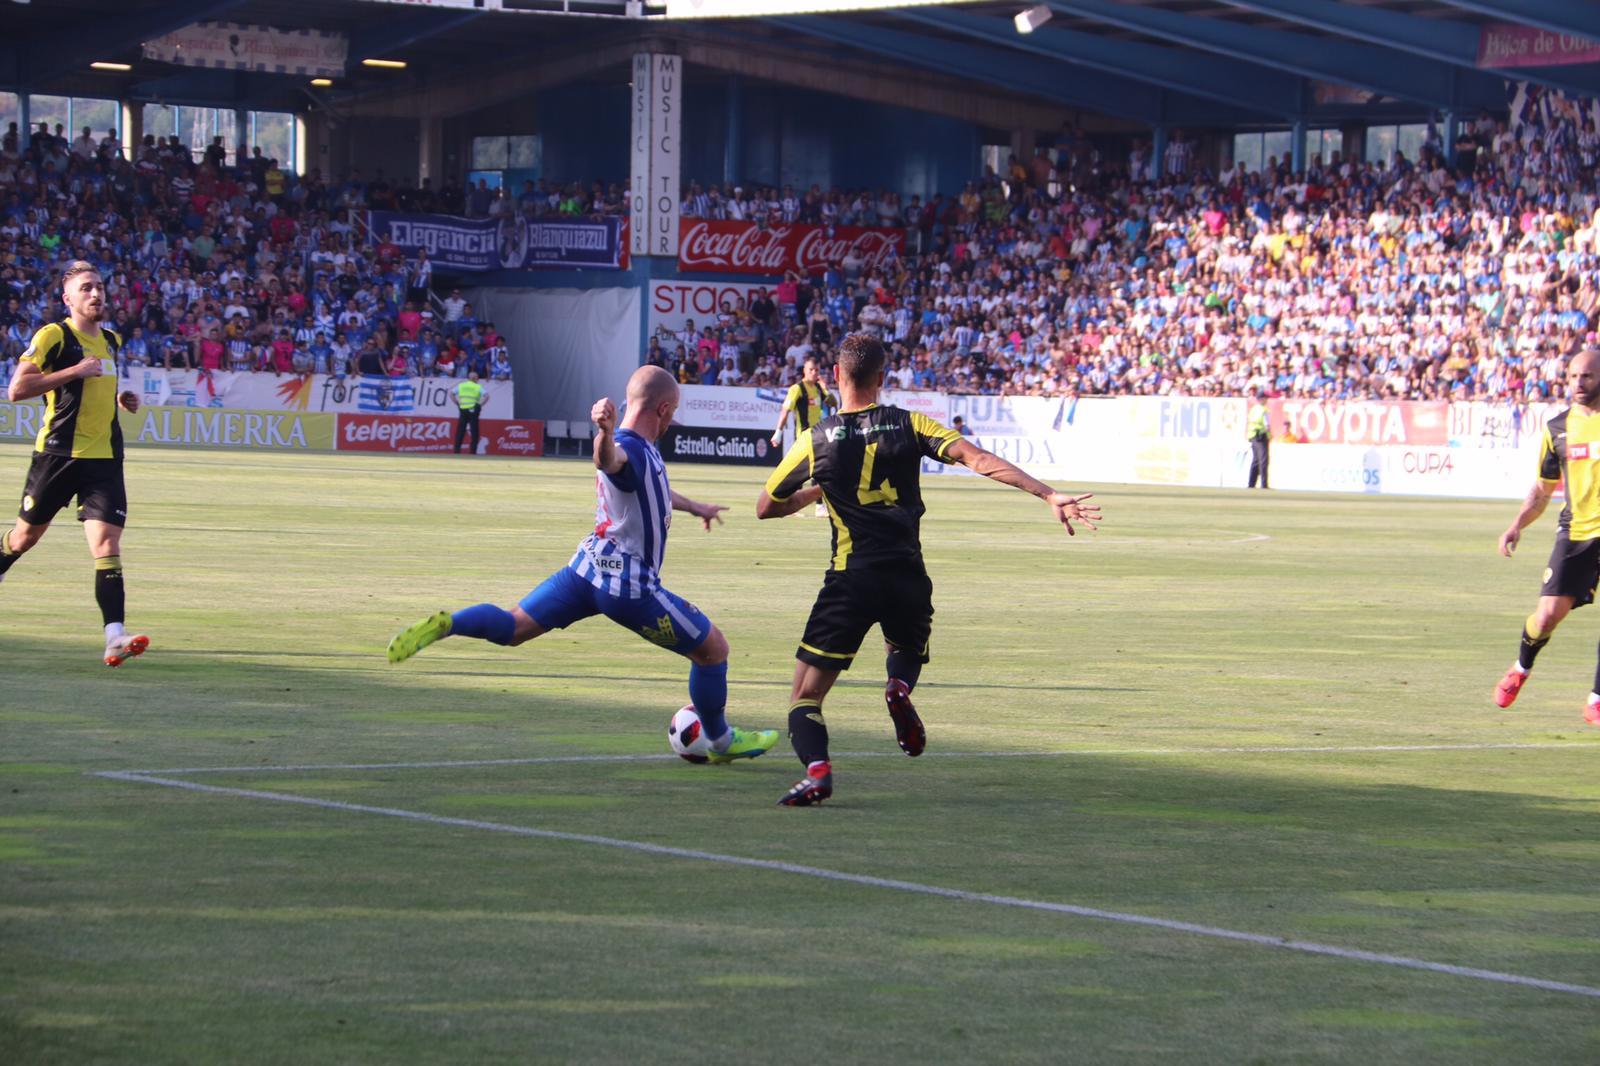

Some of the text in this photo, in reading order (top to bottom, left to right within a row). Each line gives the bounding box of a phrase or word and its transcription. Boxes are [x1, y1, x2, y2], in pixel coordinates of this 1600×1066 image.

[1534, 30, 1555, 53] de
[634, 57, 646, 252] MUSIC TOUR
[658, 57, 674, 253] MUSIC TOUR
[529, 223, 608, 255] Blanquiazul
[686, 400, 726, 412] HERRERO
[138, 410, 308, 447] ALIMERKA
[344, 418, 452, 448] telepizza
[825, 425, 847, 443] VS
[1282, 401, 1407, 443] TOYOTA
[674, 434, 755, 458] Estrella Galicia
[856, 442, 898, 506] 4
[1403, 451, 1454, 475] CUPA
